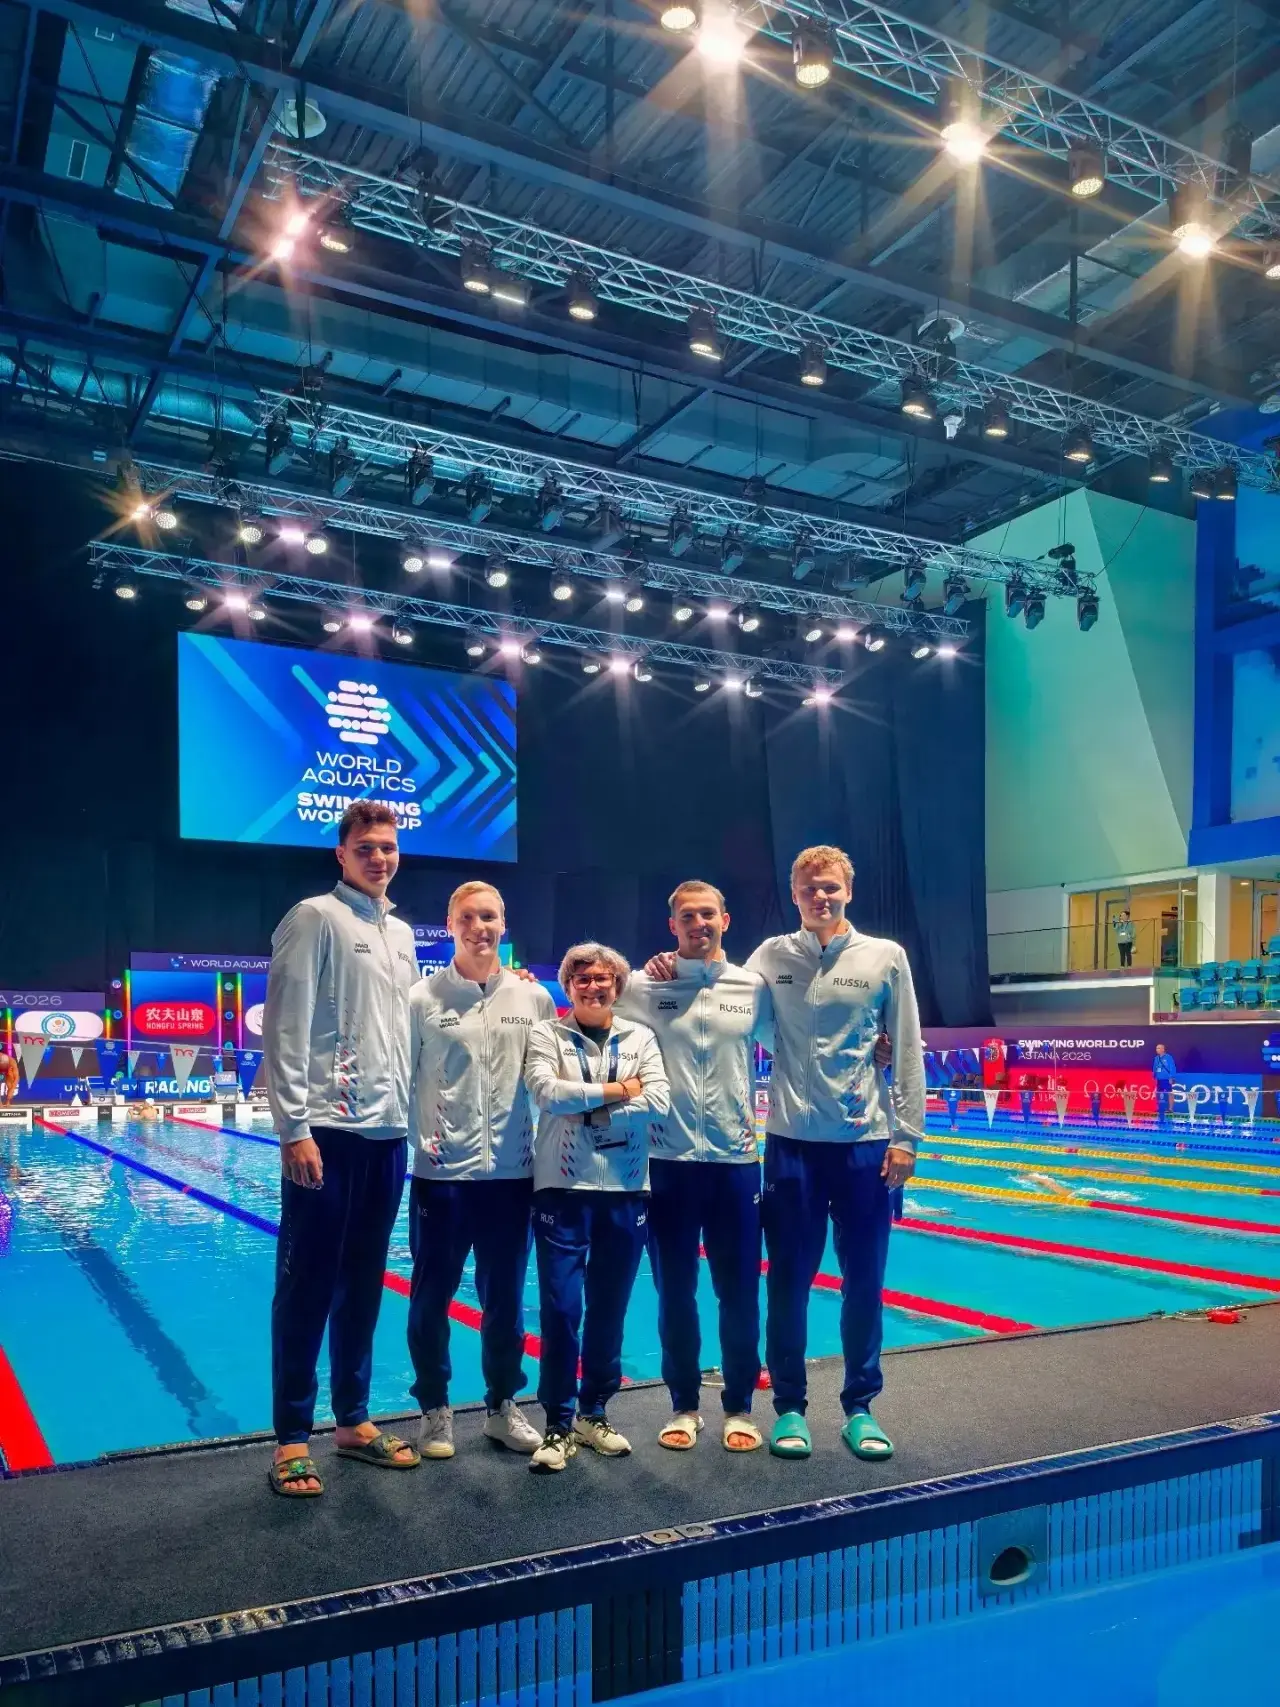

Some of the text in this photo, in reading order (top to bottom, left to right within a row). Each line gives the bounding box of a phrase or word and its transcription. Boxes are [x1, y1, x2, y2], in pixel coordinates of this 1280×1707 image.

[316, 751, 402, 774] WORLD
[301, 767, 417, 792] AQUATICS
[297, 808, 422, 830] WOR UP
[190, 959, 270, 969] WORLD AQUAT
[832, 977, 870, 990] RUSSIA
[12, 994, 63, 1006] 2026
[146, 1007, 204, 1022] 农夫山泉
[719, 1003, 752, 1016] RUSSIA
[178, 1022, 204, 1030] SPRING
[439, 1020, 461, 1029] WAVE
[500, 1016, 534, 1027] RUSSIA
[23, 1036, 45, 1046] TYR
[1076, 1039, 1118, 1048] WORLD
[1119, 1039, 1145, 1048] CUP
[174, 1048, 194, 1057] TYR
[1018, 1051, 1092, 1061] ASTANA 2026
[145, 1080, 211, 1094] RACNG
[1171, 1083, 1259, 1105] SONY
[540, 1213, 555, 1225] RUS
